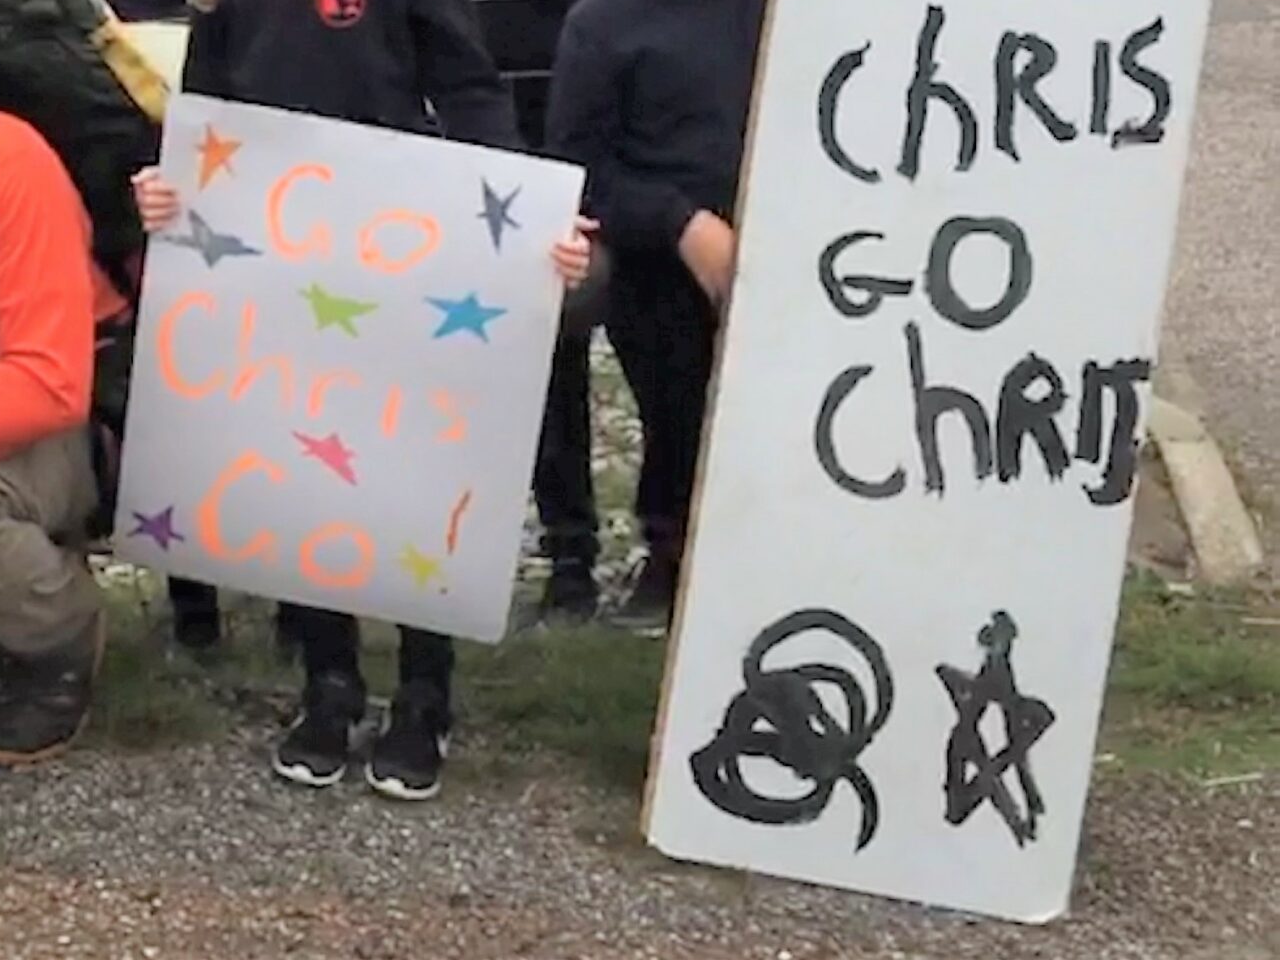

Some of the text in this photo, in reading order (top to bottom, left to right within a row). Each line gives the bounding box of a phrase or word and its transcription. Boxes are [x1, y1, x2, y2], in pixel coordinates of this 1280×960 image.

[266, 164, 442, 275] Go
[818, 215, 1033, 331] GO
[157, 291, 476, 439] Chris
